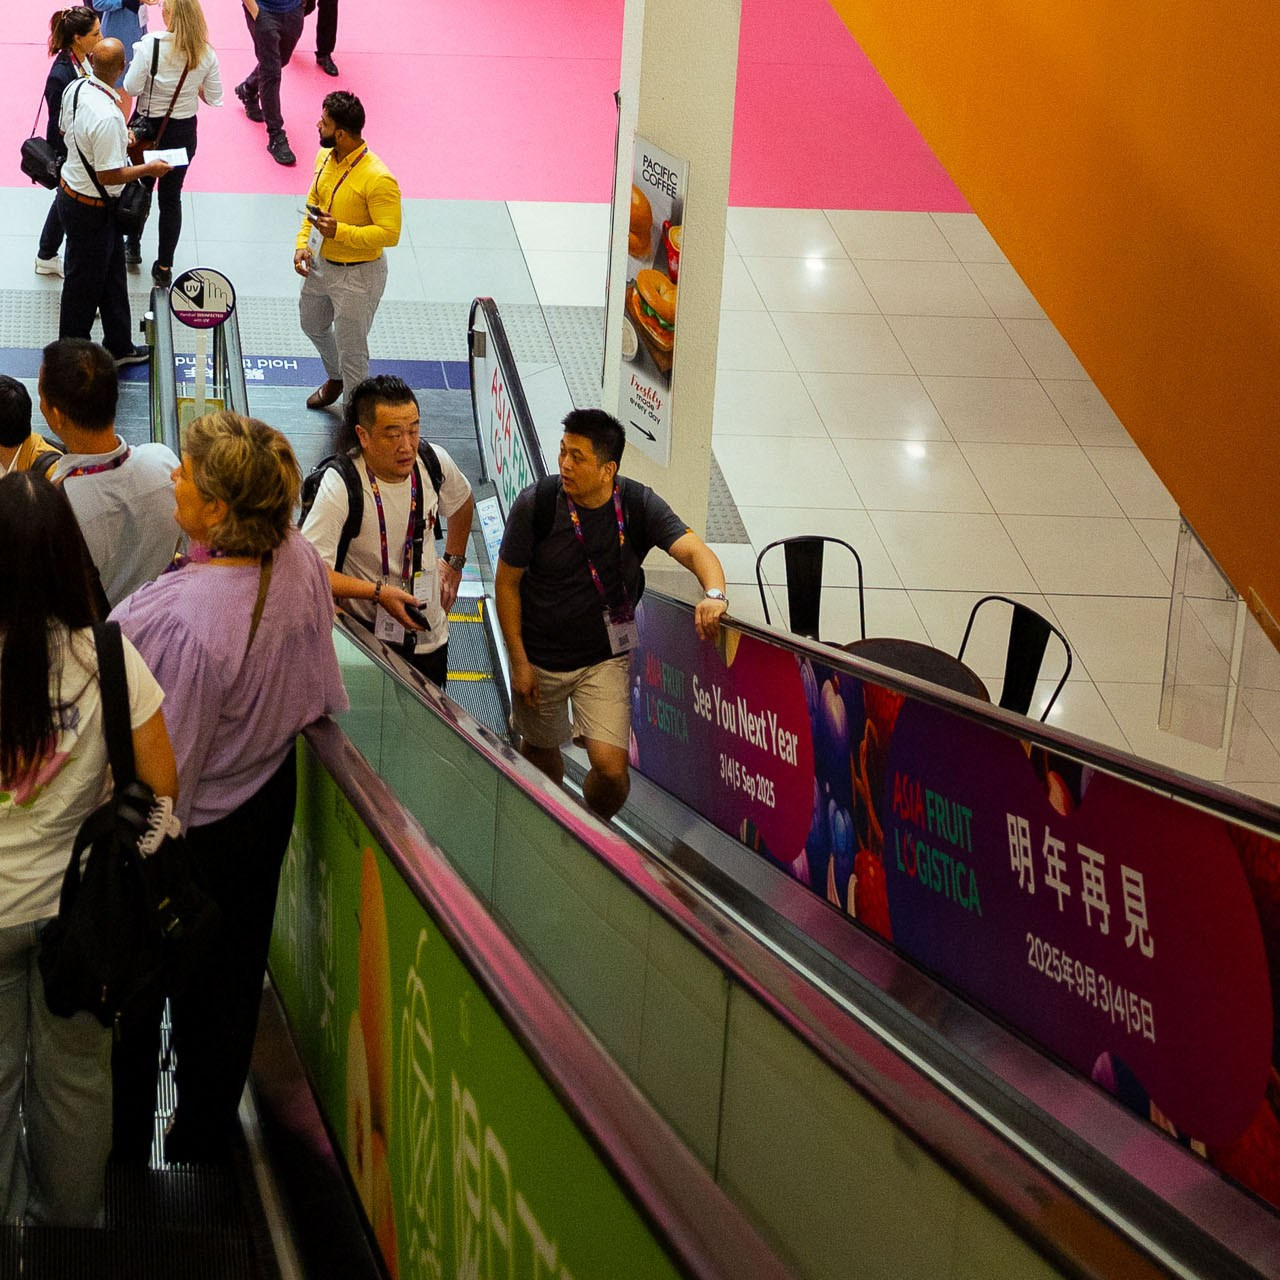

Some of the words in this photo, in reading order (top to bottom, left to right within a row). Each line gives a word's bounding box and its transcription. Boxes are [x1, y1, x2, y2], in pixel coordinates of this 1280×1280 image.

[641, 169, 677, 200] COFFEE
[642, 154, 678, 187] PACIFIC
[258, 359, 297, 369] Hold
[630, 373, 663, 410] Freshly
[635, 392, 655, 411] made
[629, 397, 647, 416] every
[647, 407, 661, 425] day
[692, 674, 712, 721] See
[712, 684, 737, 735] You
[737, 696, 768, 751] Next
[767, 710, 798, 766] Year
[741, 765, 756, 802] Sep
[756, 773, 775, 808] 2025
[892, 770, 926, 831] ASIA
[925, 789, 972, 854] FRUIT
[895, 827, 982, 918] LOGISTICA
[1006, 812, 1154, 959] 明年再見
